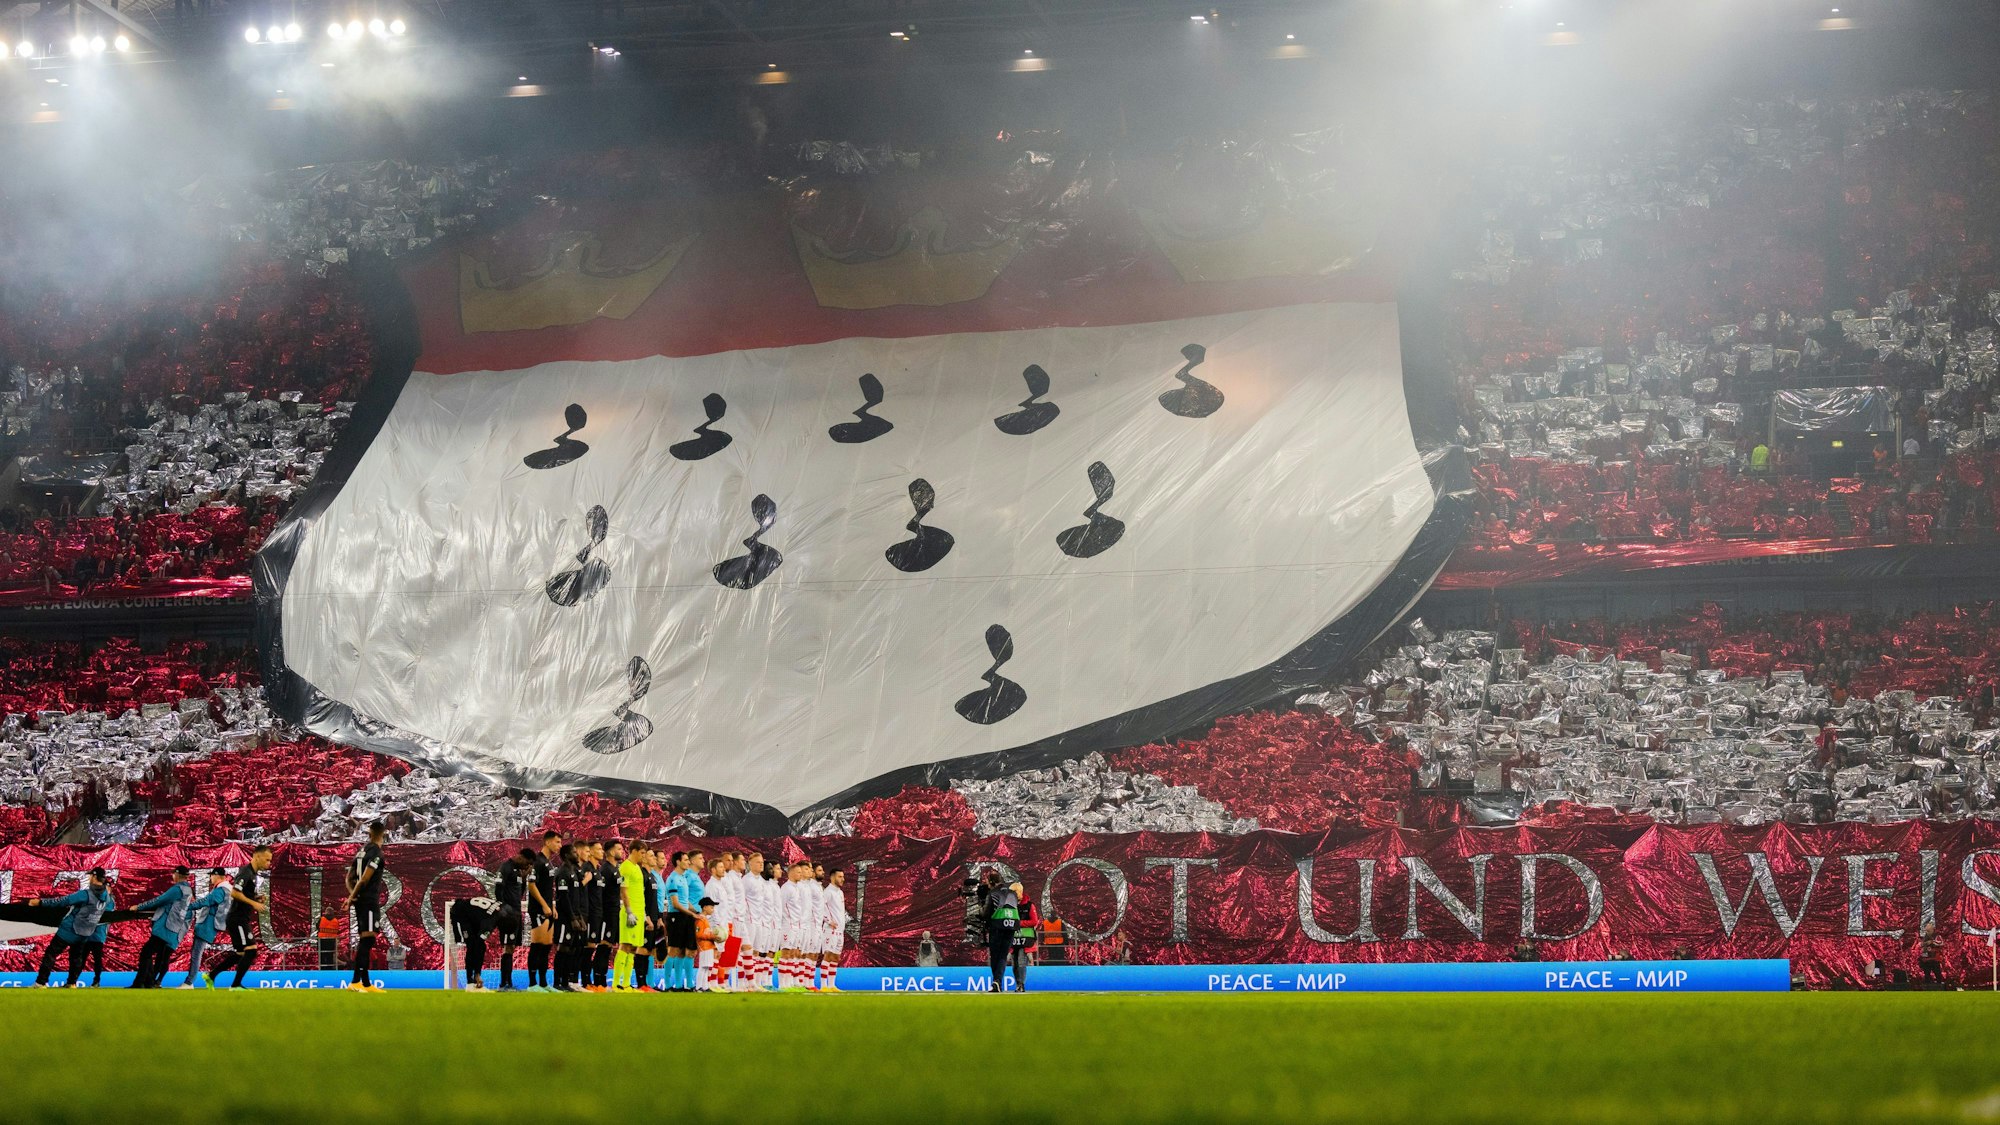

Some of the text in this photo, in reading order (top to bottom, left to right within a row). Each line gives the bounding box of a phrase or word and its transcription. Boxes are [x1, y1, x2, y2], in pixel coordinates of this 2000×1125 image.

[1295, 852, 1603, 943] UND
[881, 976, 945, 992] PEACE
[1208, 973, 1274, 991] PEACE
[1296, 973, 1347, 990] МИР
[1545, 971, 1614, 989] PEACE
[1636, 970, 1688, 988] МИР
